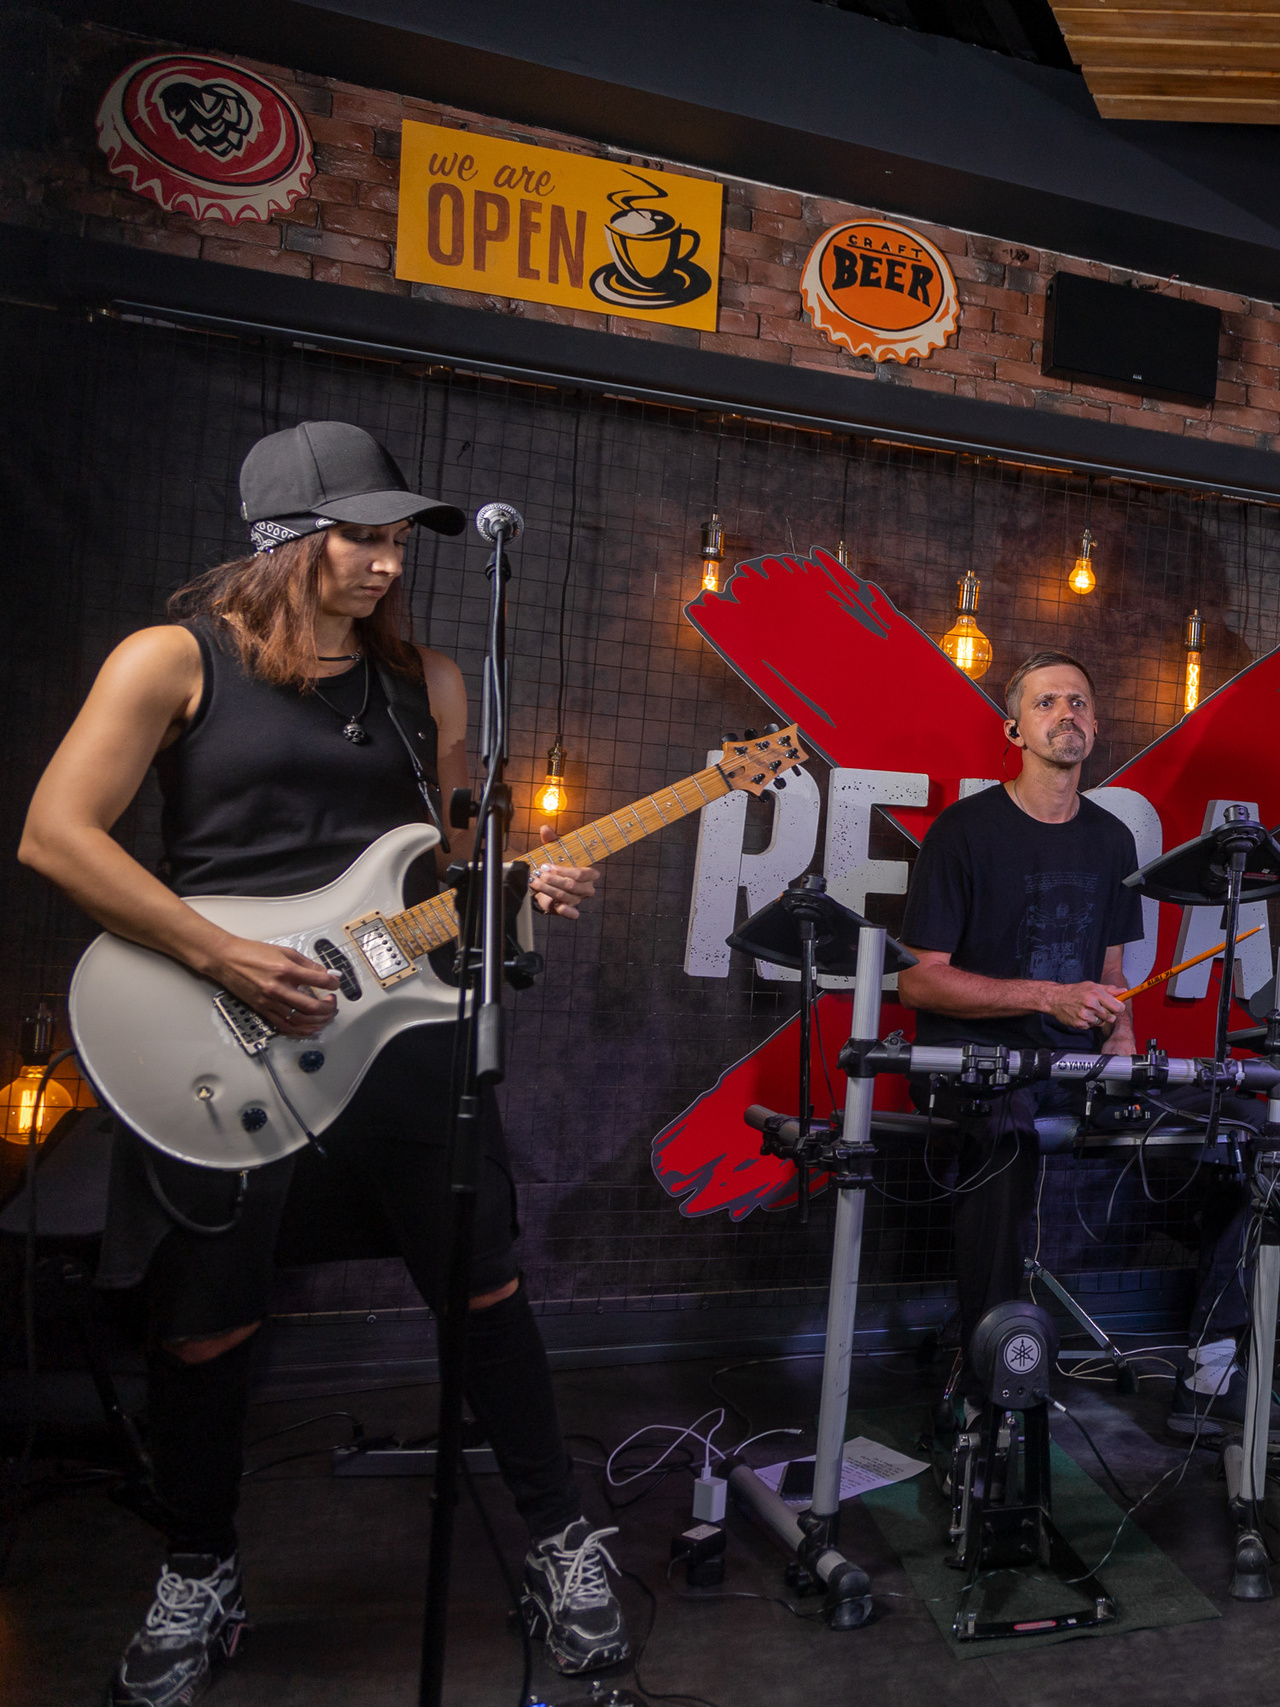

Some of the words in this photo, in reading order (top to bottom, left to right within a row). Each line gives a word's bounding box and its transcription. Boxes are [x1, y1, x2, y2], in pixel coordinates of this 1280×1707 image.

[428, 152, 478, 181] we
[494, 165, 555, 196] are
[427, 182, 587, 289] OPEN
[848, 234, 922, 258] CRAFT
[832, 245, 933, 307] BEER
[1069, 1061, 1095, 1071] YAMA
